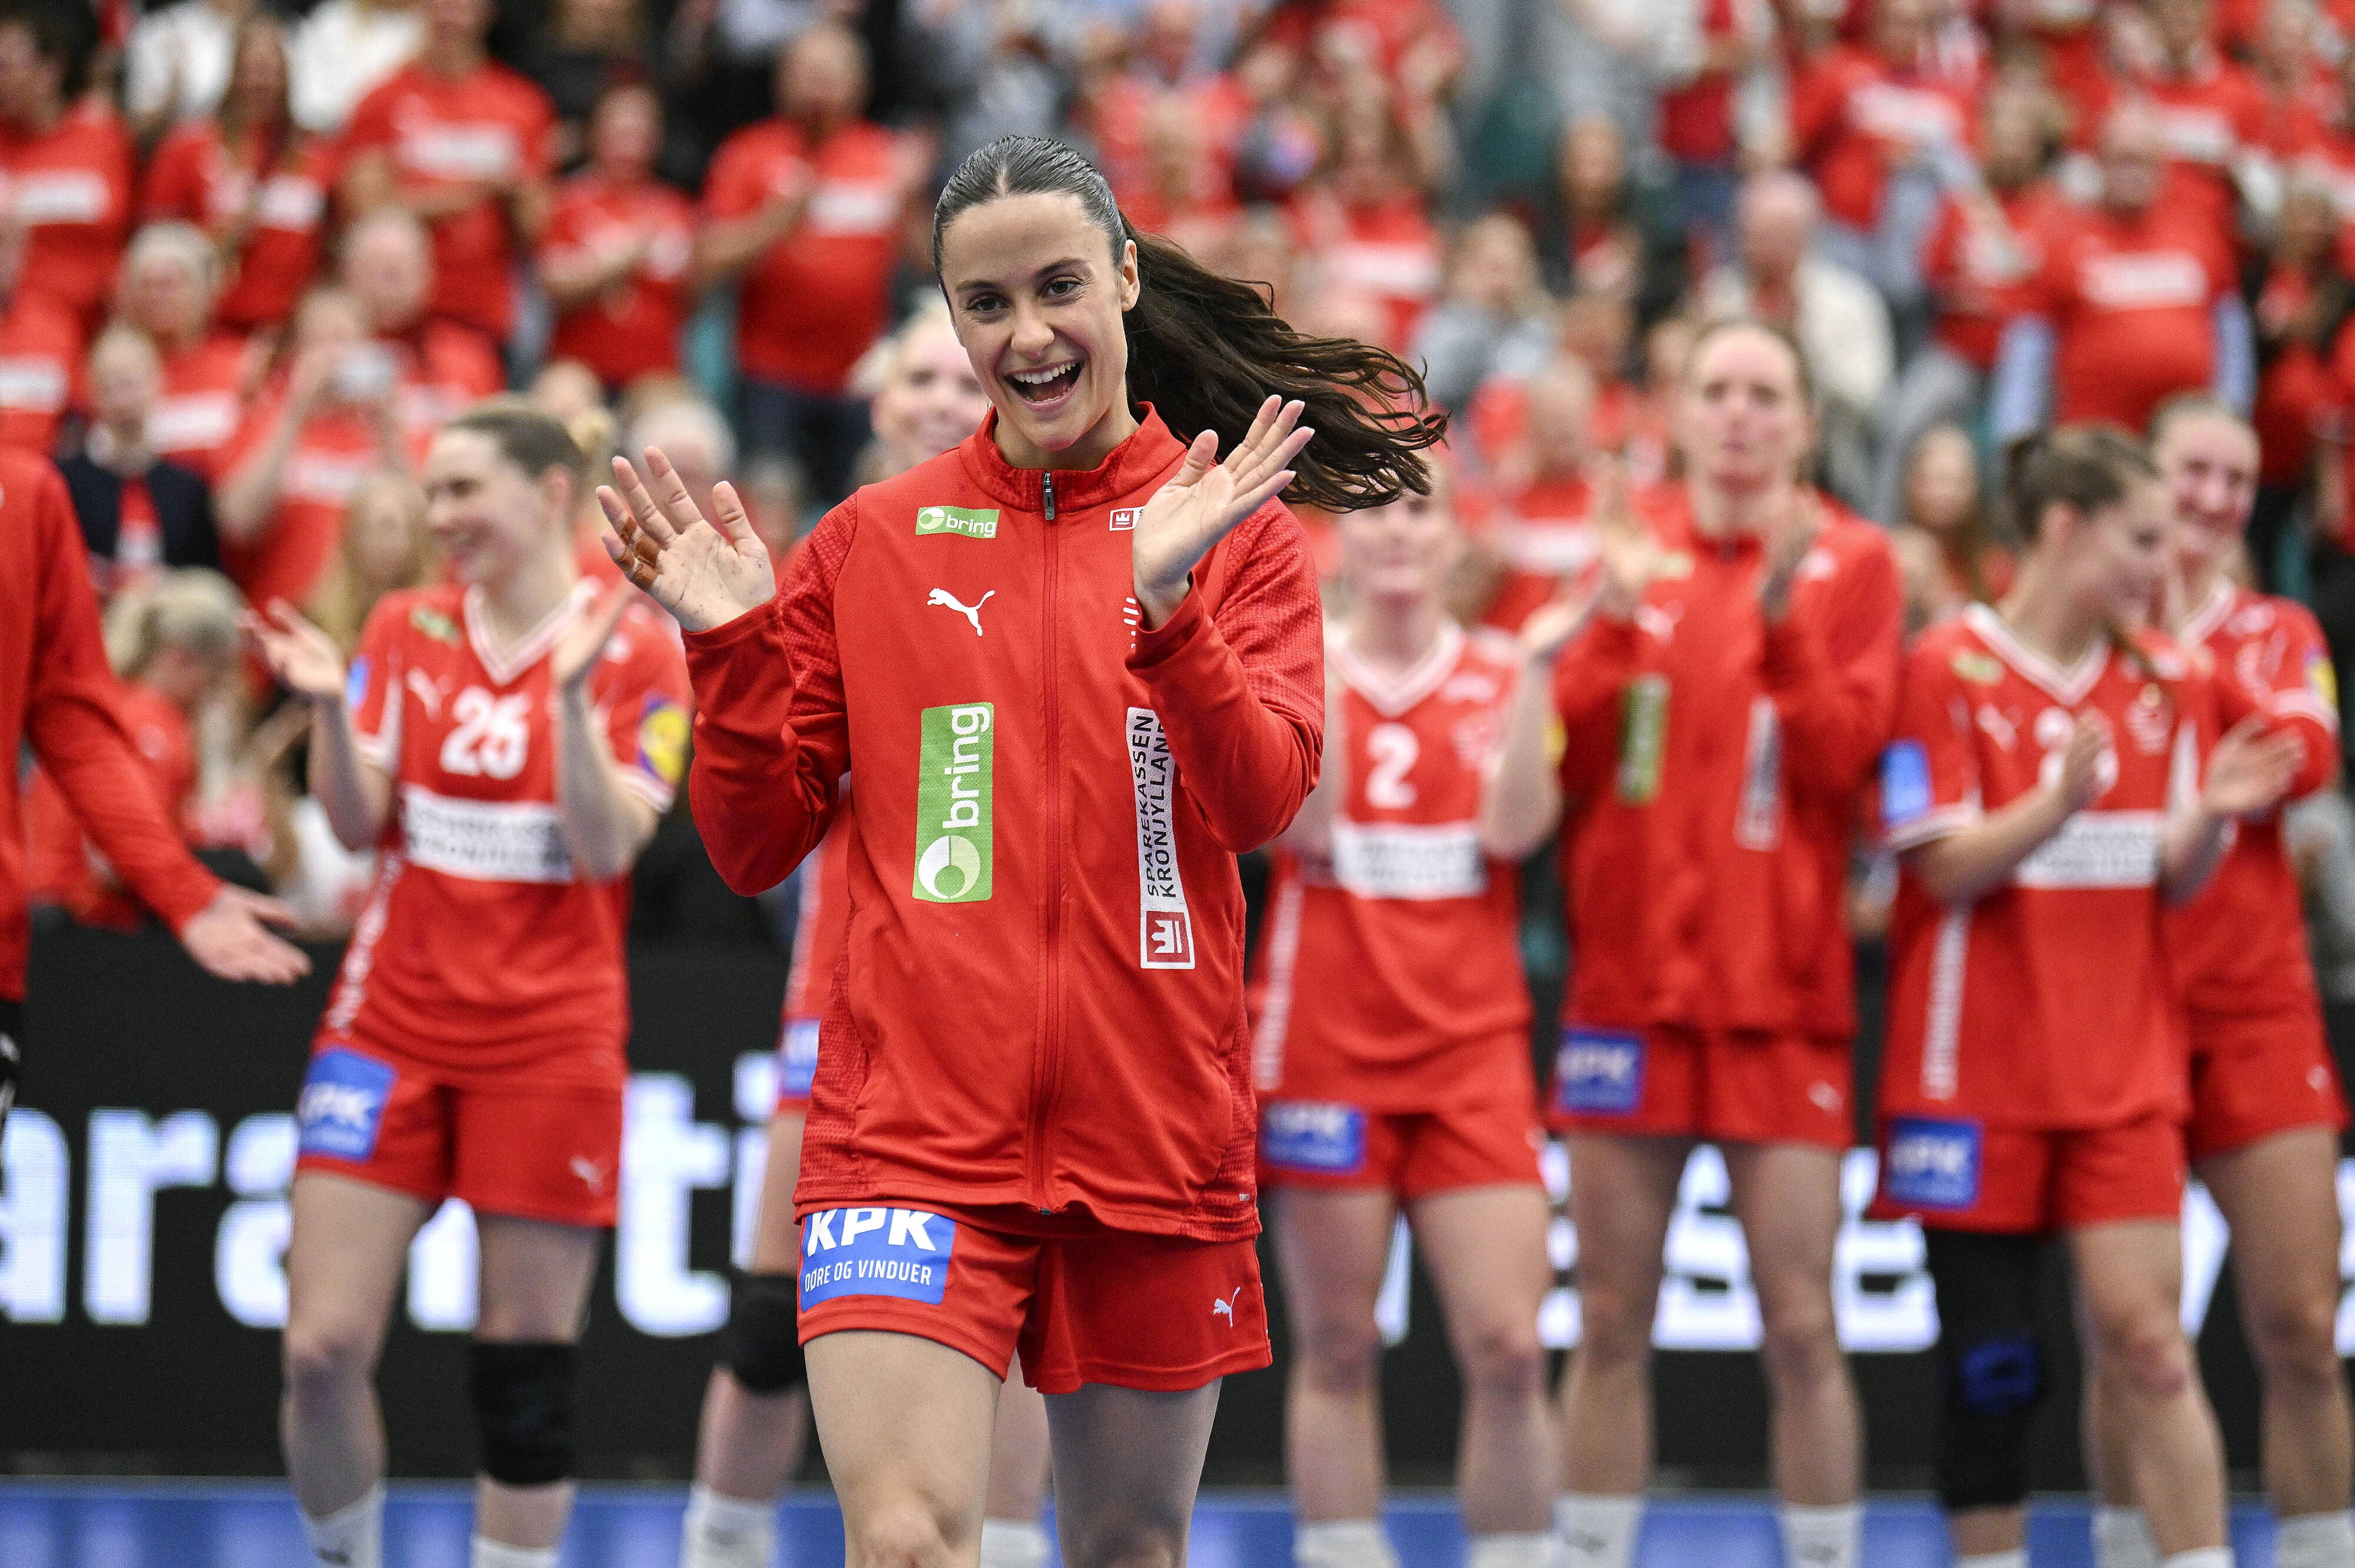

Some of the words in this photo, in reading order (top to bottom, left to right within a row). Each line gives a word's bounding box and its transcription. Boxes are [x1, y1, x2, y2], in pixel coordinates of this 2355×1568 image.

[946, 514, 997, 537] bring
[942, 706, 990, 829] bring
[1366, 722, 1421, 809] 2
[1132, 715, 1159, 897] SPAREKASSEN
[807, 1207, 936, 1258] KPK
[805, 1265, 831, 1293] DØRE
[834, 1261, 853, 1281] OG
[858, 1260, 931, 1286] VINDUER
